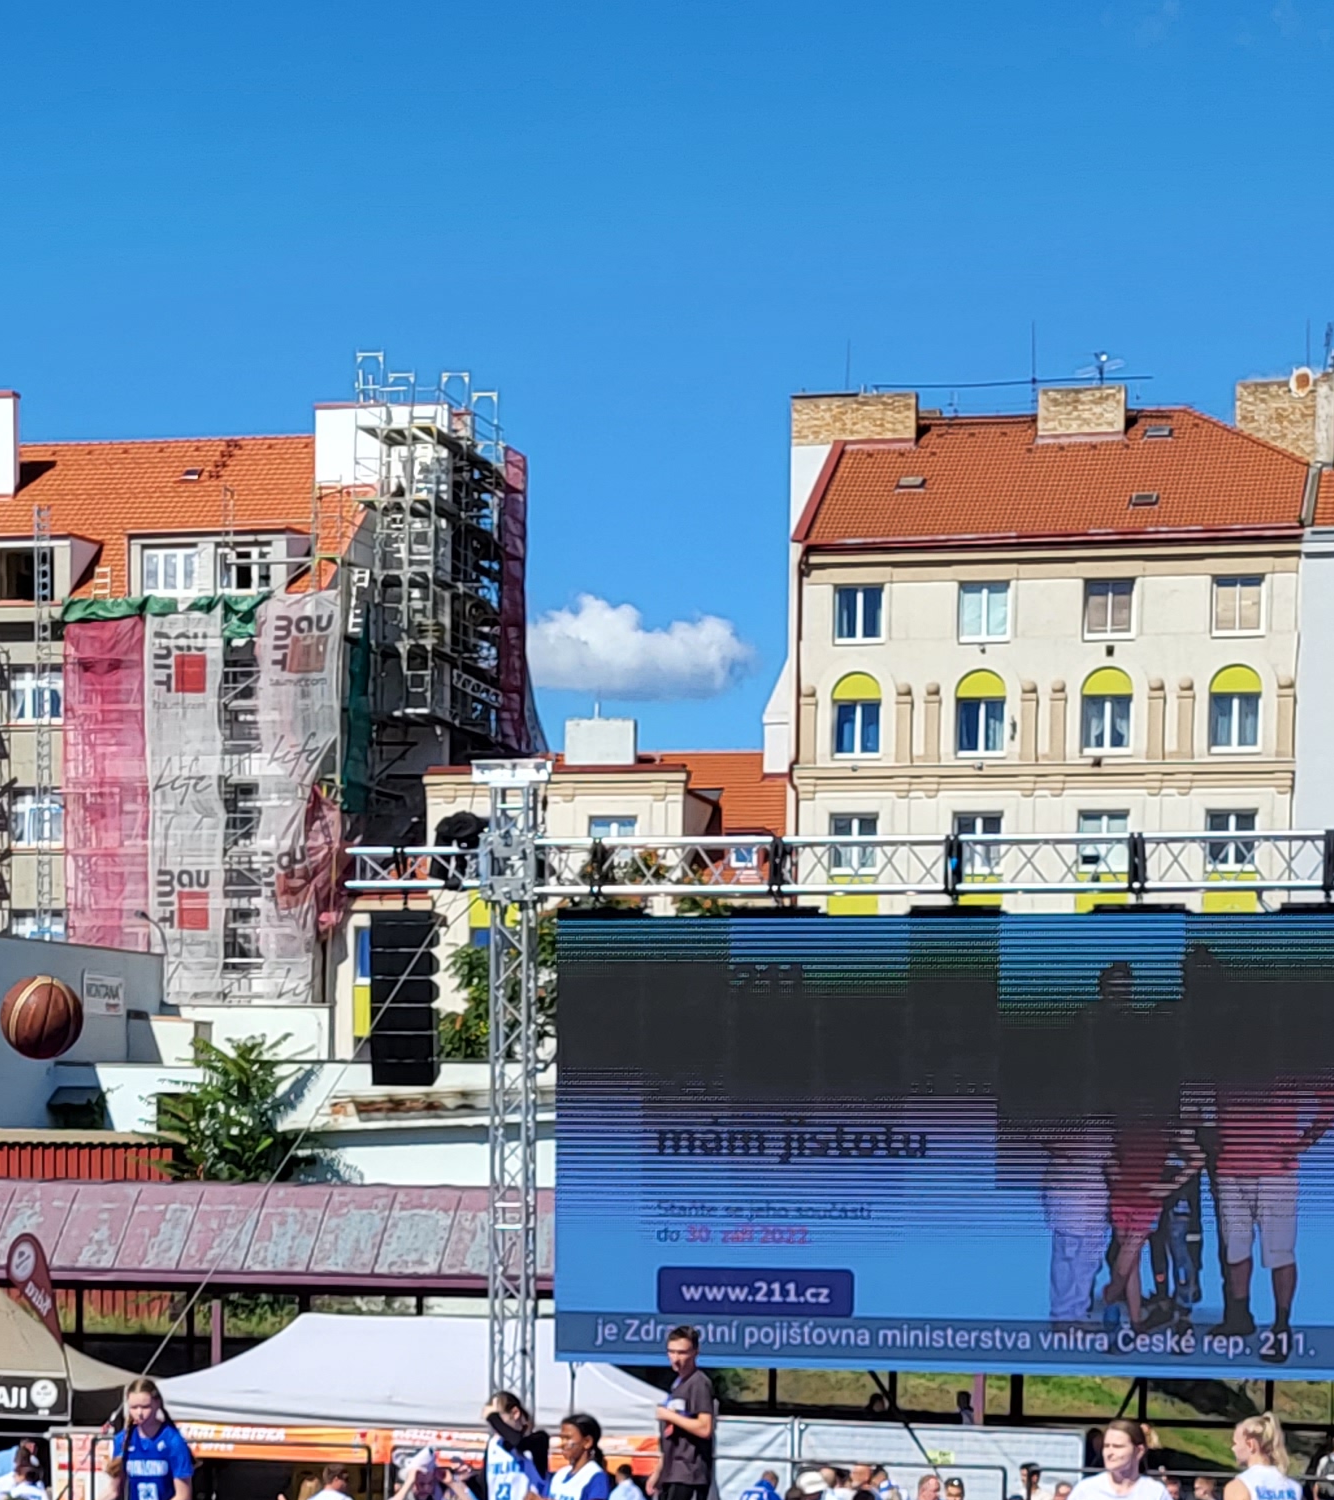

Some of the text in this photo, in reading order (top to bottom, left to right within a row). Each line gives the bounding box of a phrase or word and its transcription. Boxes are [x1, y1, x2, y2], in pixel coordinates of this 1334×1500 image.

[681, 1280, 831, 1305] www.211.cz
[594, 1318, 1316, 1359] je Zdrotní pojišťovna ministerstva vnitra České rep. 211.
